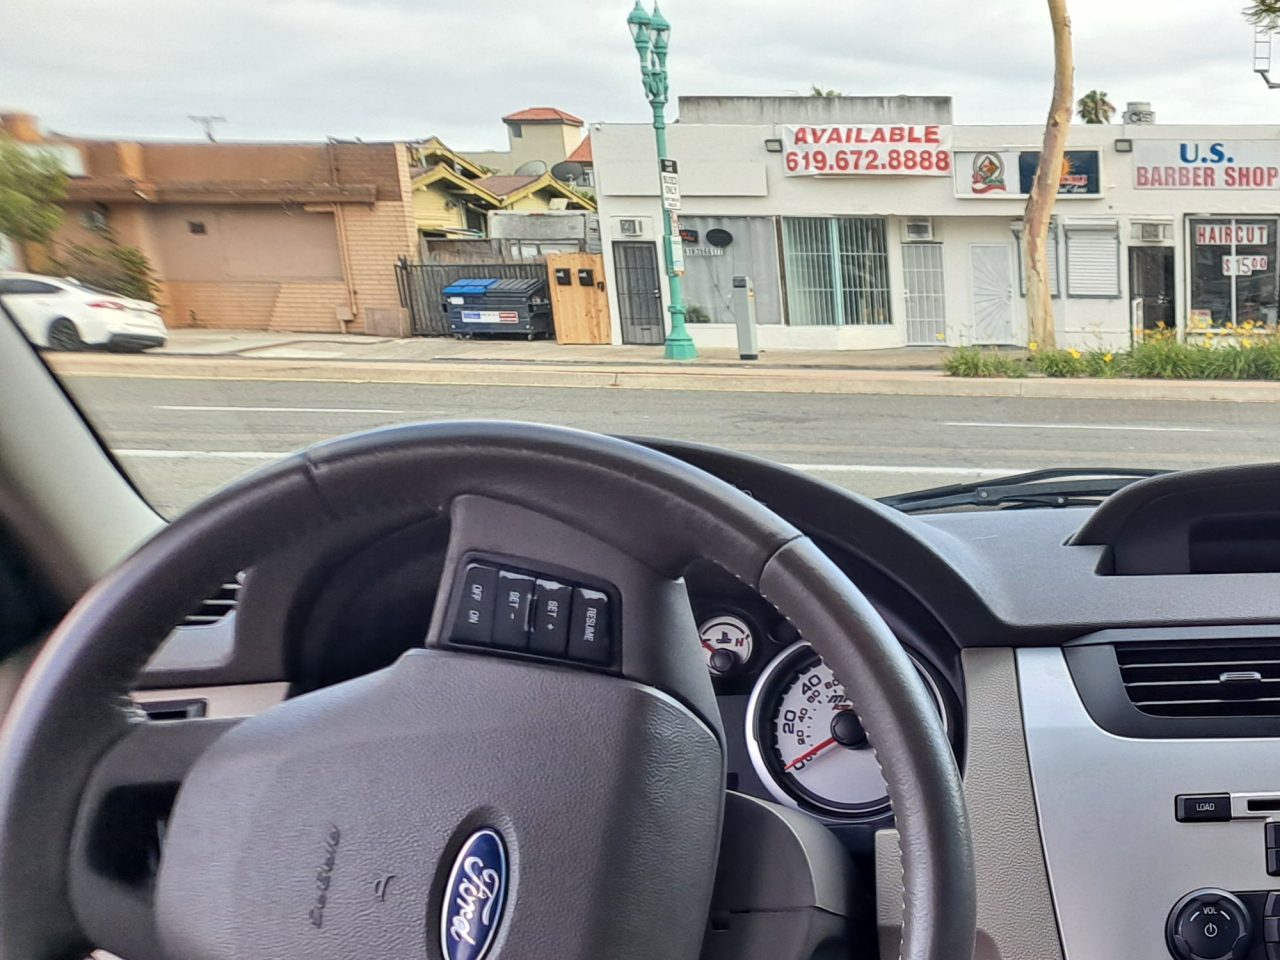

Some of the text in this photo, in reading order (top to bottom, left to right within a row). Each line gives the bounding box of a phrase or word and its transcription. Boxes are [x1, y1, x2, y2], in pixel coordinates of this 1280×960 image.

[794, 126, 940, 145] AVAILABLE
[786, 149, 951, 171] 619.672.8888
[1179, 143, 1234, 164] U.S.
[1136, 166, 1279, 187] BARBER SHOP
[1198, 226, 1267, 243] HAIRCUT
[468, 584, 483, 624] OFF ON
[584, 607, 598, 642] RESUME
[735, 638, 744, 647] H
[802, 674, 822, 695] 40
[783, 710, 796, 734] 20
[798, 708, 808, 722] 40
[1196, 802, 1215, 811] LOAD
[450, 856, 500, 946] Ford
